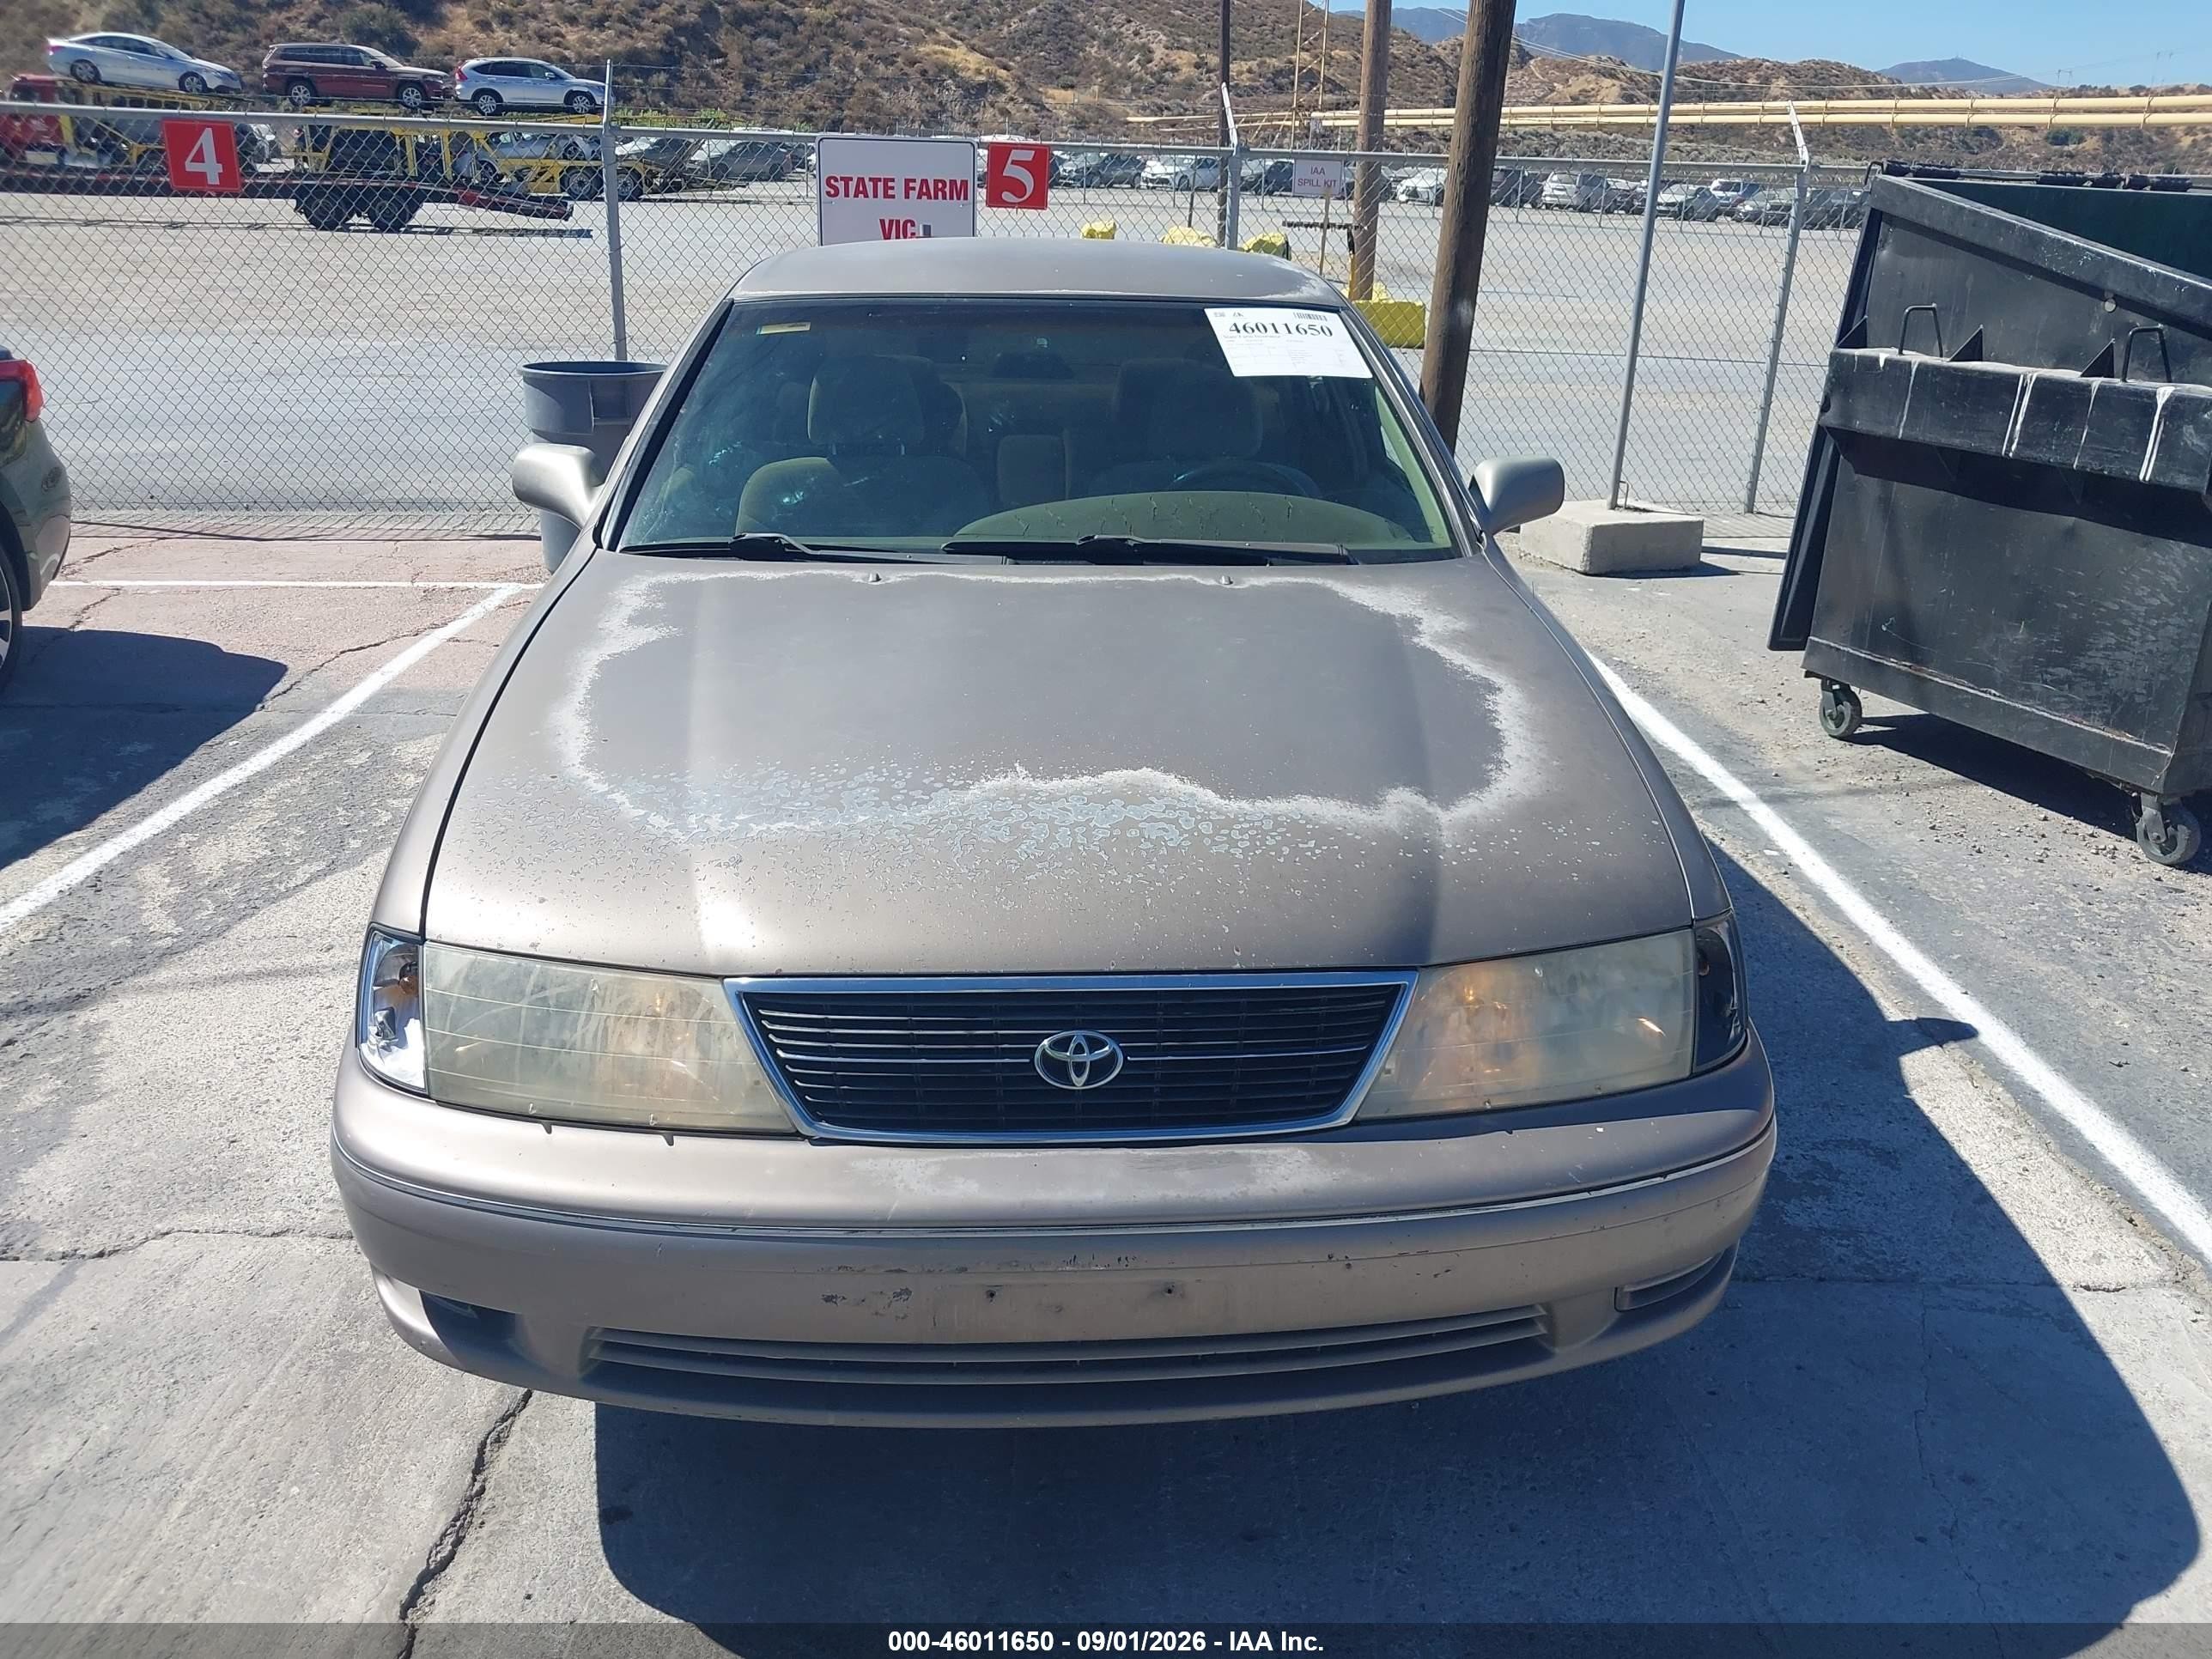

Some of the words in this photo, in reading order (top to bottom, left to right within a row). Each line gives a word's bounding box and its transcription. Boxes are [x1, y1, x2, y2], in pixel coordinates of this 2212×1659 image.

[185, 128, 223, 185] 4
[1001, 149, 1035, 204] 5
[1310, 166, 1326, 175] IAA
[825, 175, 896, 199] STATE
[903, 178, 969, 201] FARM
[1297, 178, 1321, 187] SPILL
[1229, 321, 1334, 337] 46011650
